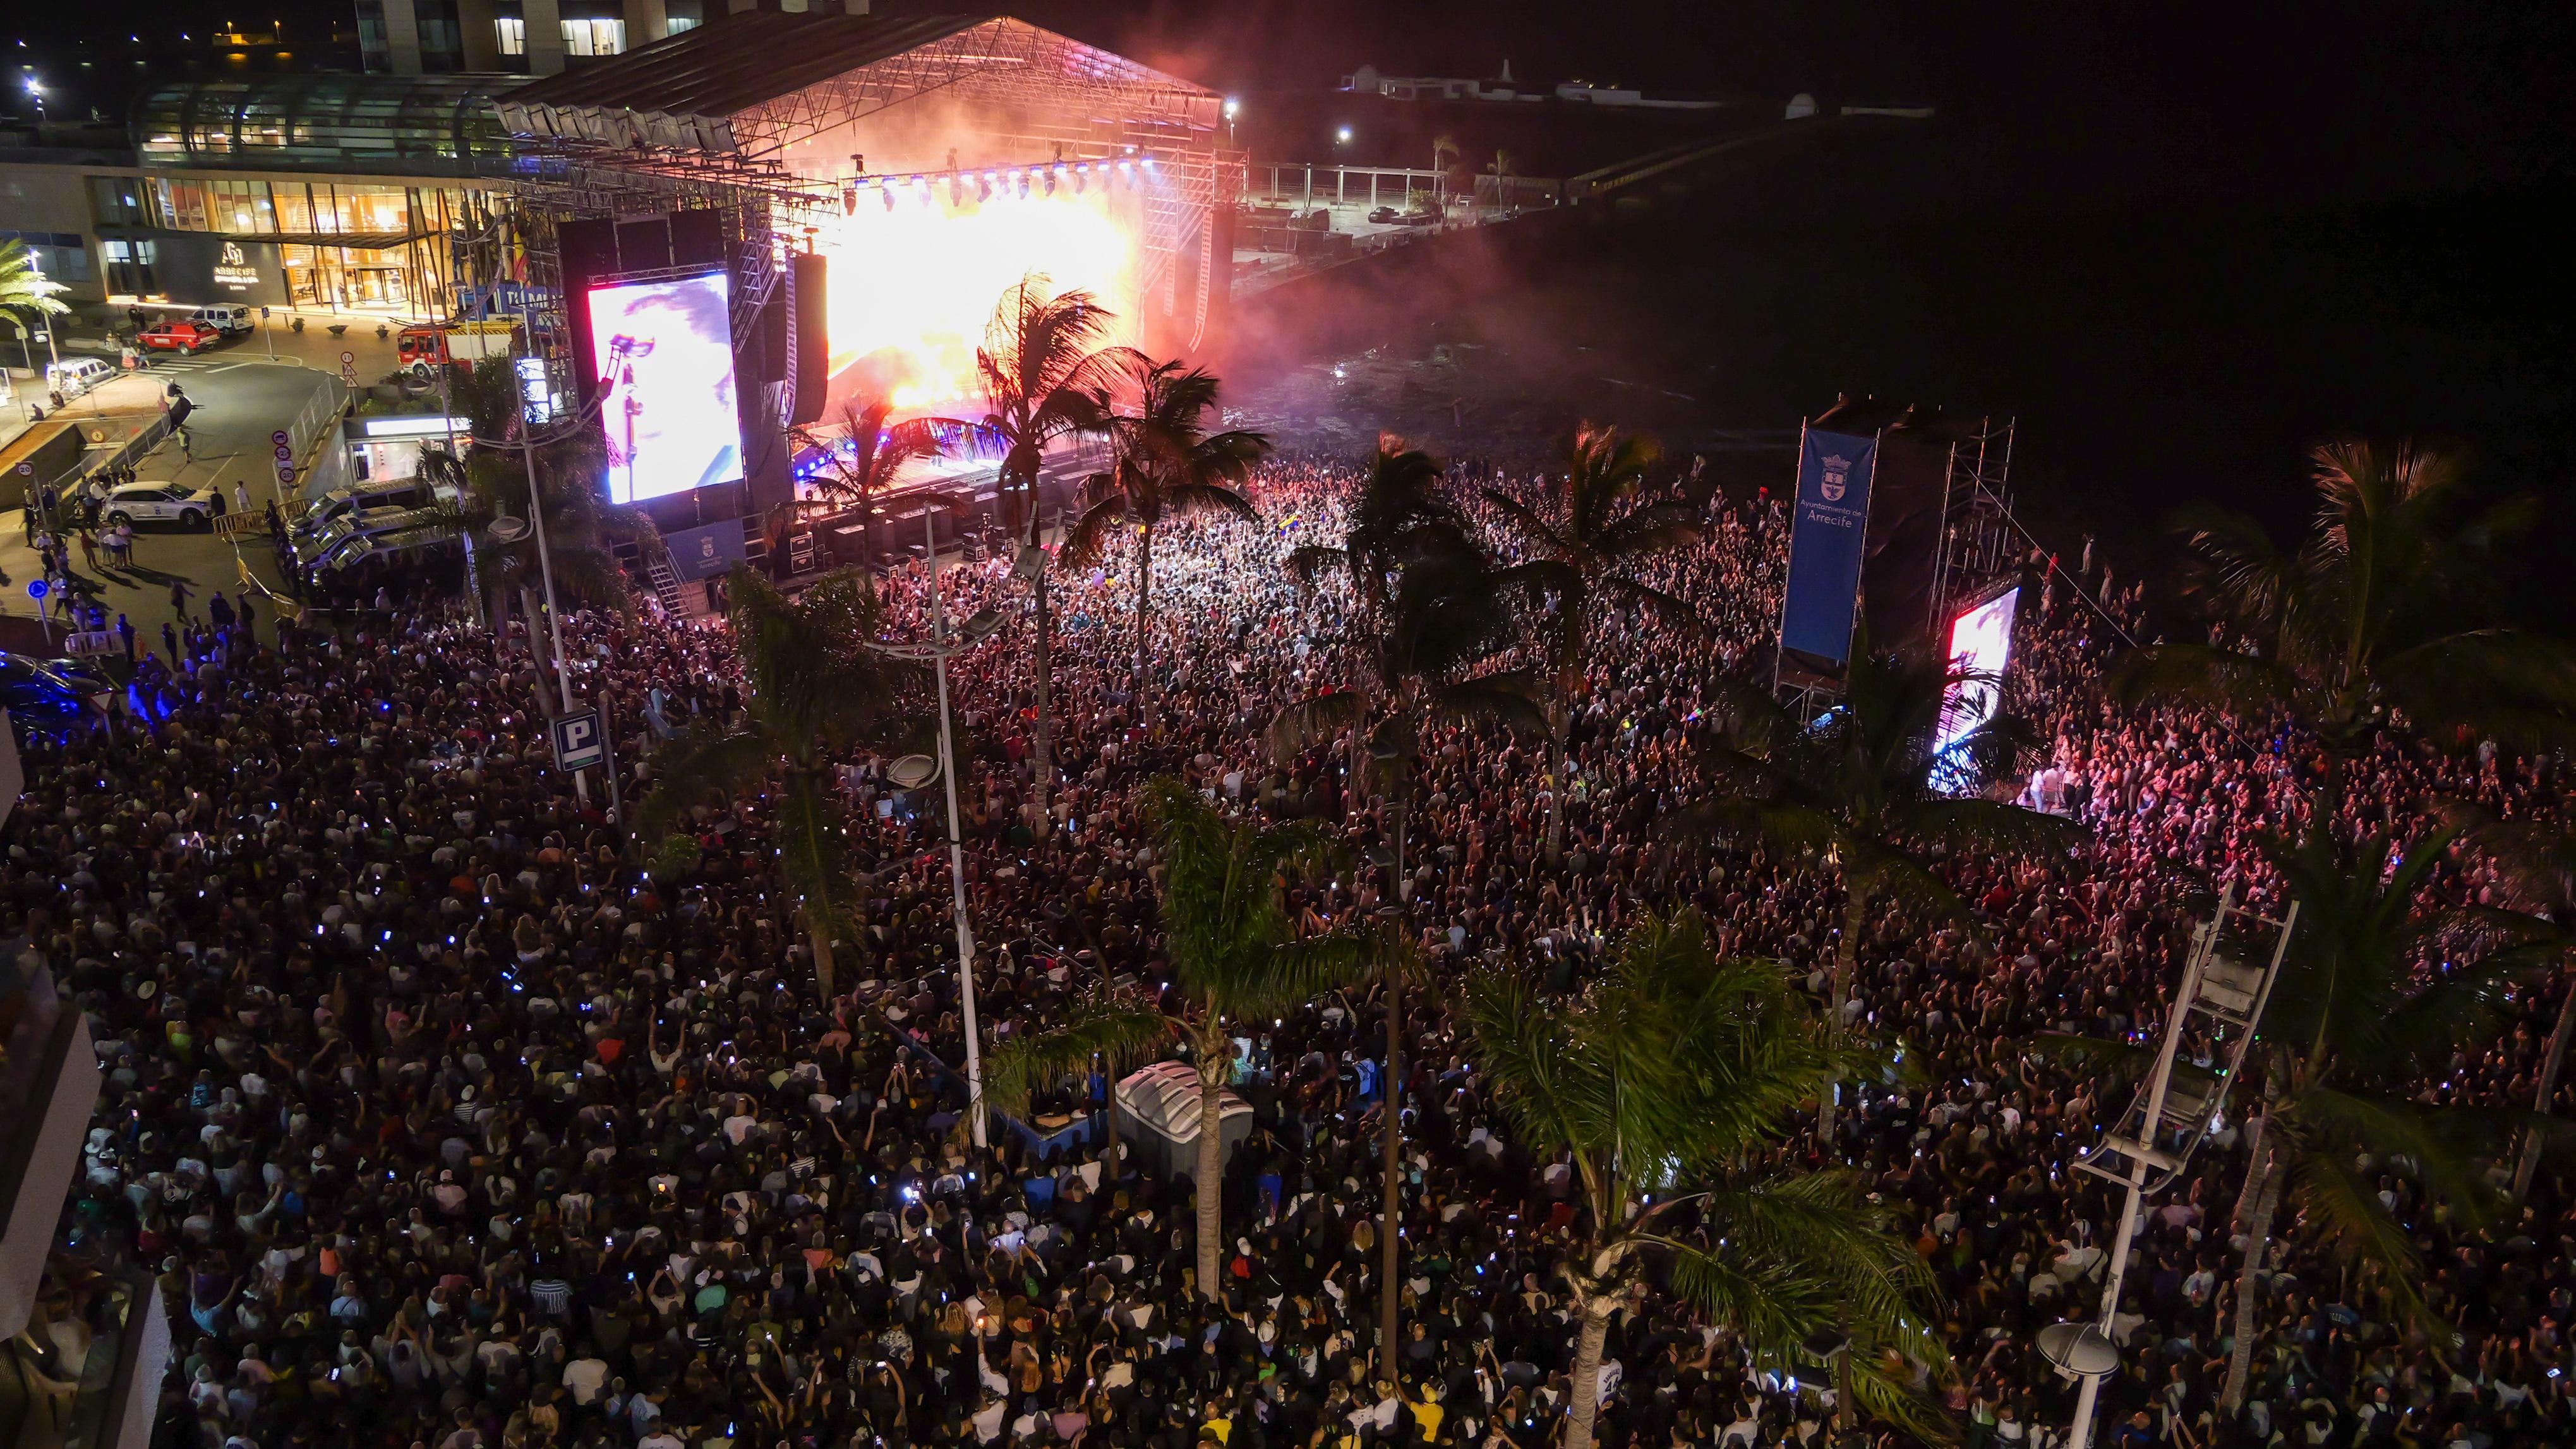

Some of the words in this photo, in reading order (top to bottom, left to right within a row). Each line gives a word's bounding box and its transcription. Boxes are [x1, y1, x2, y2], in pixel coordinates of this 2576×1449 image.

[1800, 499, 1851, 515] Ayuntamiento
[1807, 509, 1852, 528] Arrecife
[565, 720, 591, 750] P
